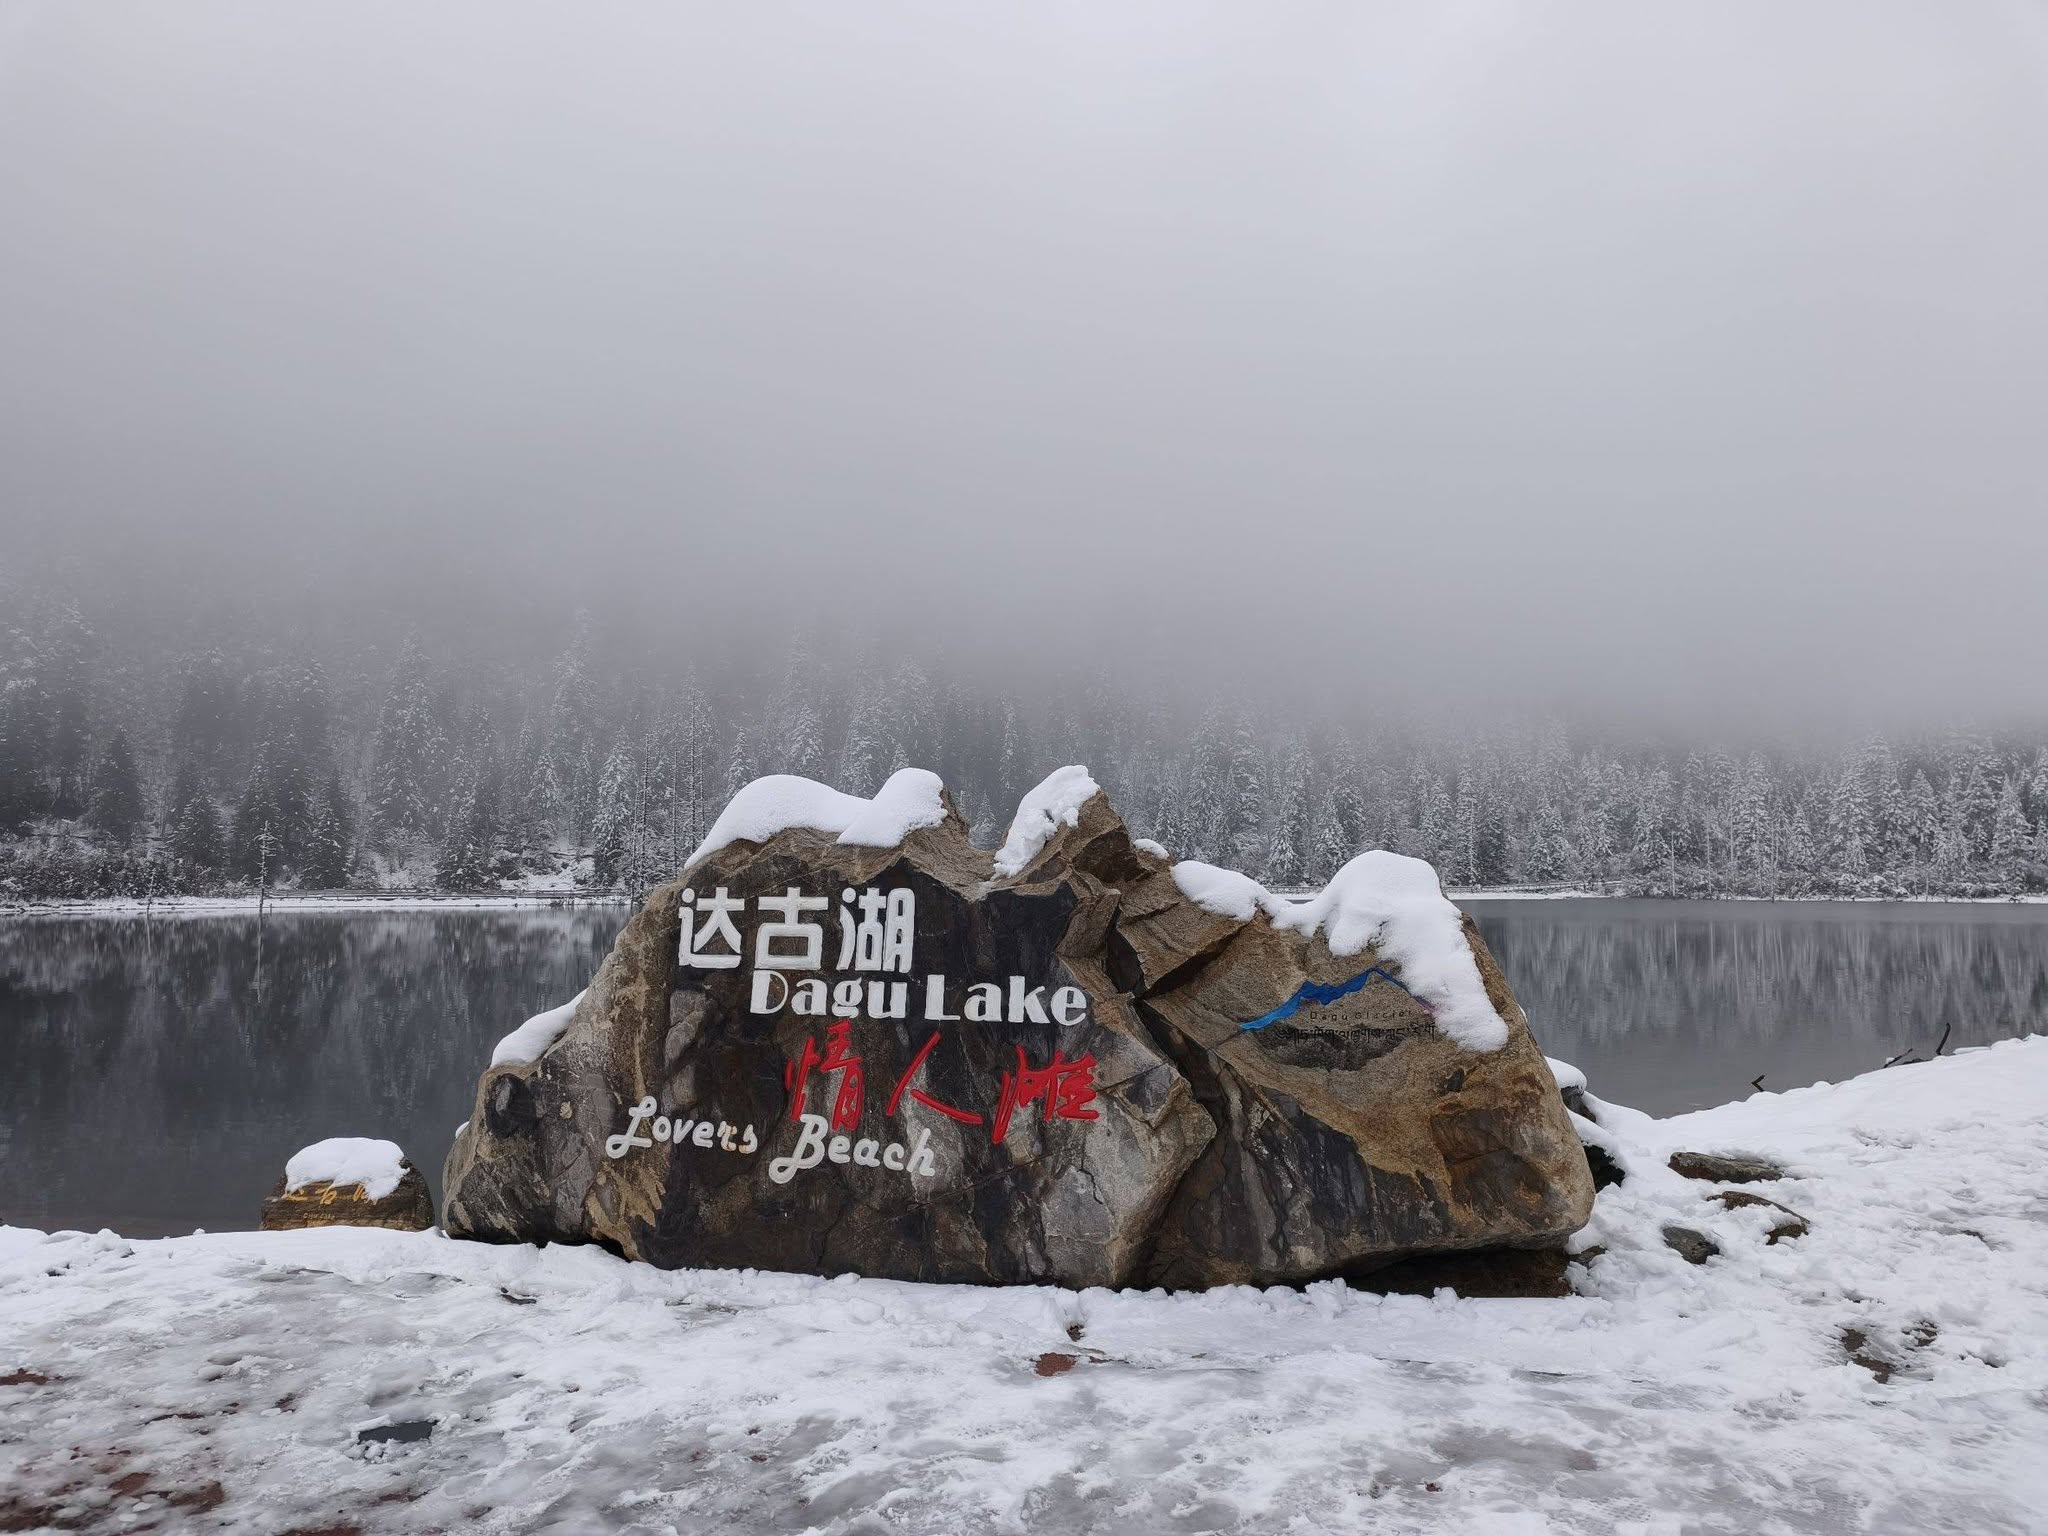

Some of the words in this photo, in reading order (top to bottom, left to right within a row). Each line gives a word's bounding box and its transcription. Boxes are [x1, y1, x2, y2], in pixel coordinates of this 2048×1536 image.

[677, 886, 916, 975] 达古湖
[749, 970, 908, 1019] Dagu
[924, 974, 1089, 1026] Lake
[604, 1095, 758, 1160] Lovers
[768, 1114, 937, 1186] Beach
